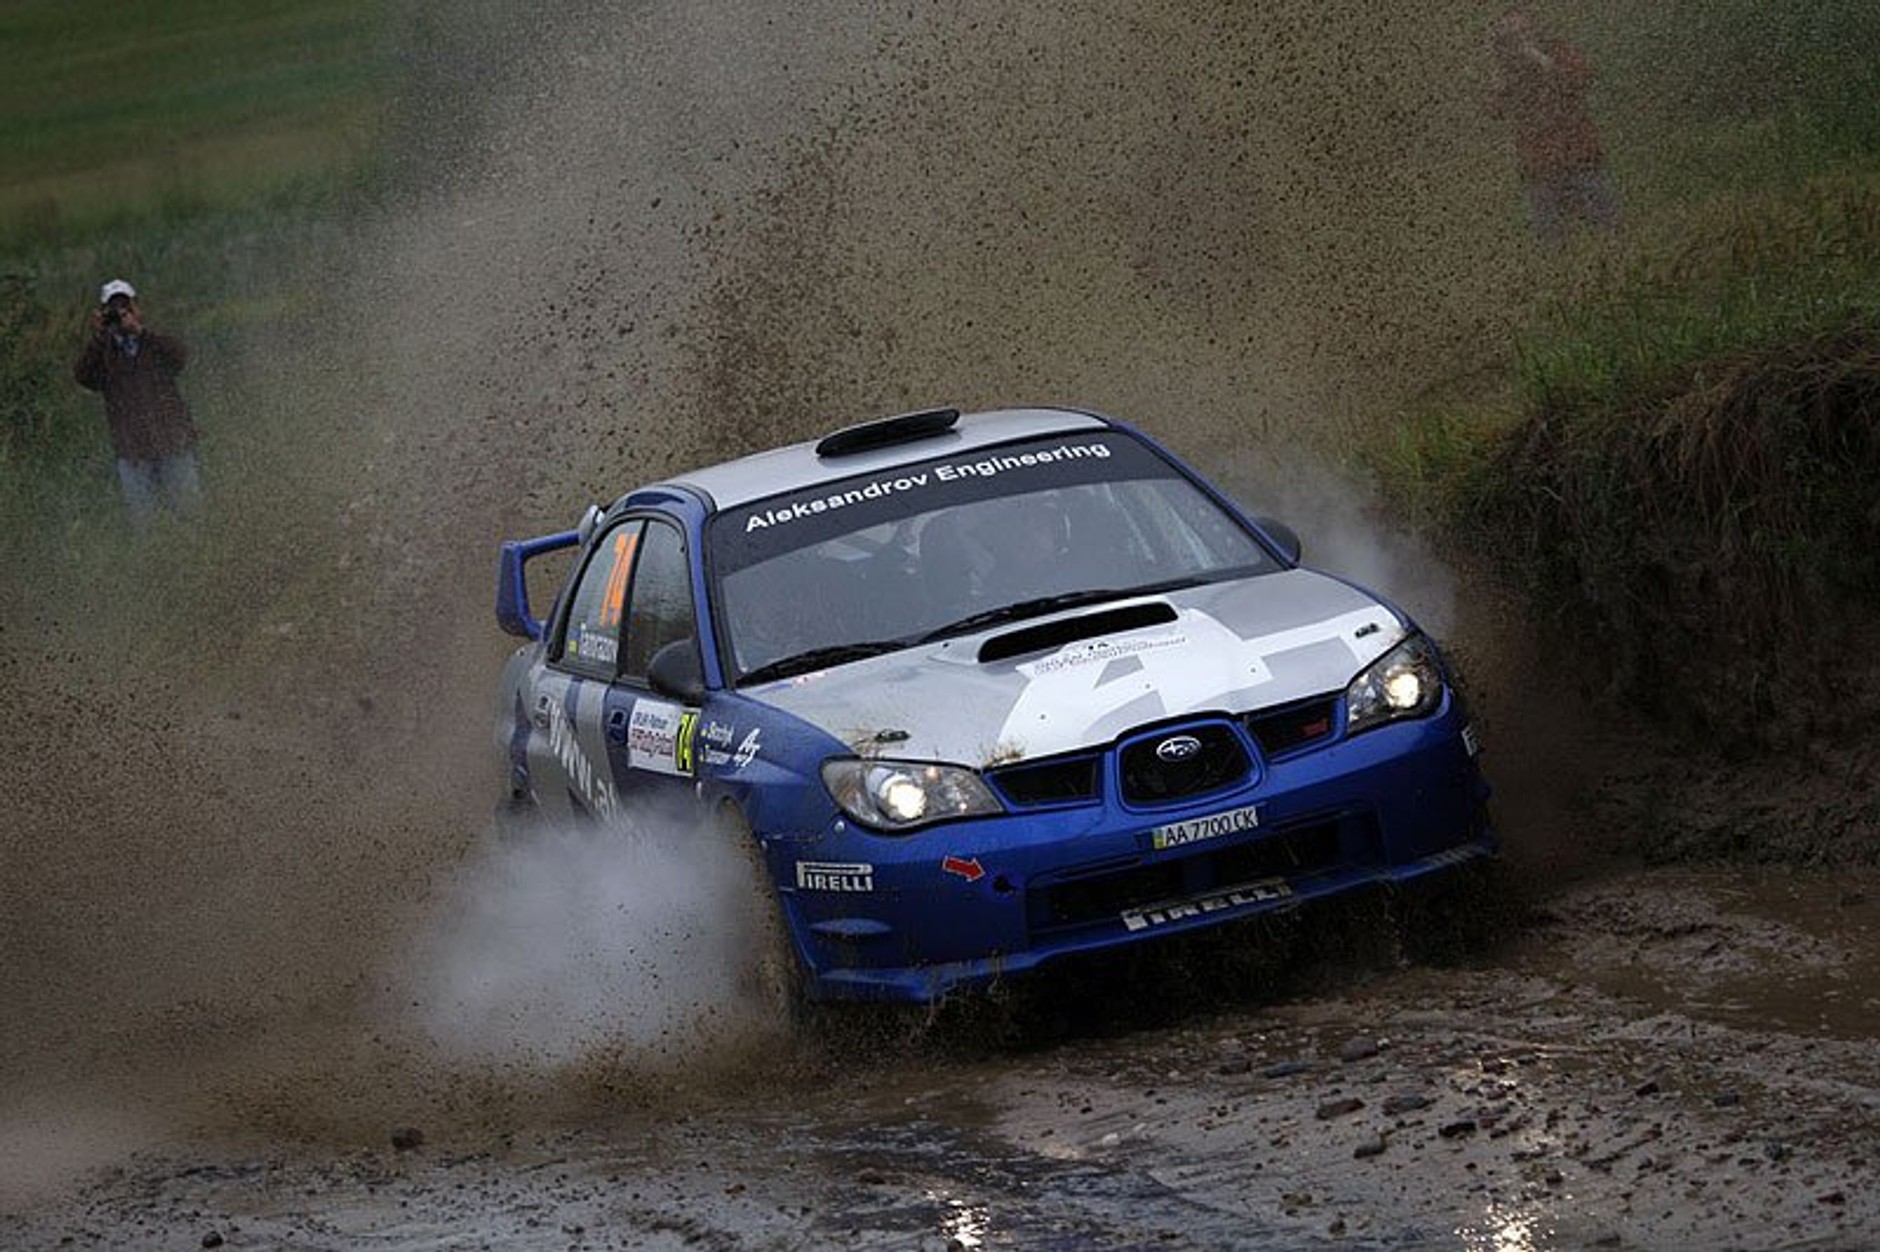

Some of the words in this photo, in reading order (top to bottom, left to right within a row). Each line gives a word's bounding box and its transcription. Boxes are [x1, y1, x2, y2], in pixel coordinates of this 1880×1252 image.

[745, 470, 928, 533] Aleksandrov
[935, 442, 1111, 482] Engineering
[1165, 825, 1188, 846] AA
[1190, 815, 1231, 839] 7700
[1233, 808, 1257, 829] CK
[796, 861, 873, 892] PIRELLI
